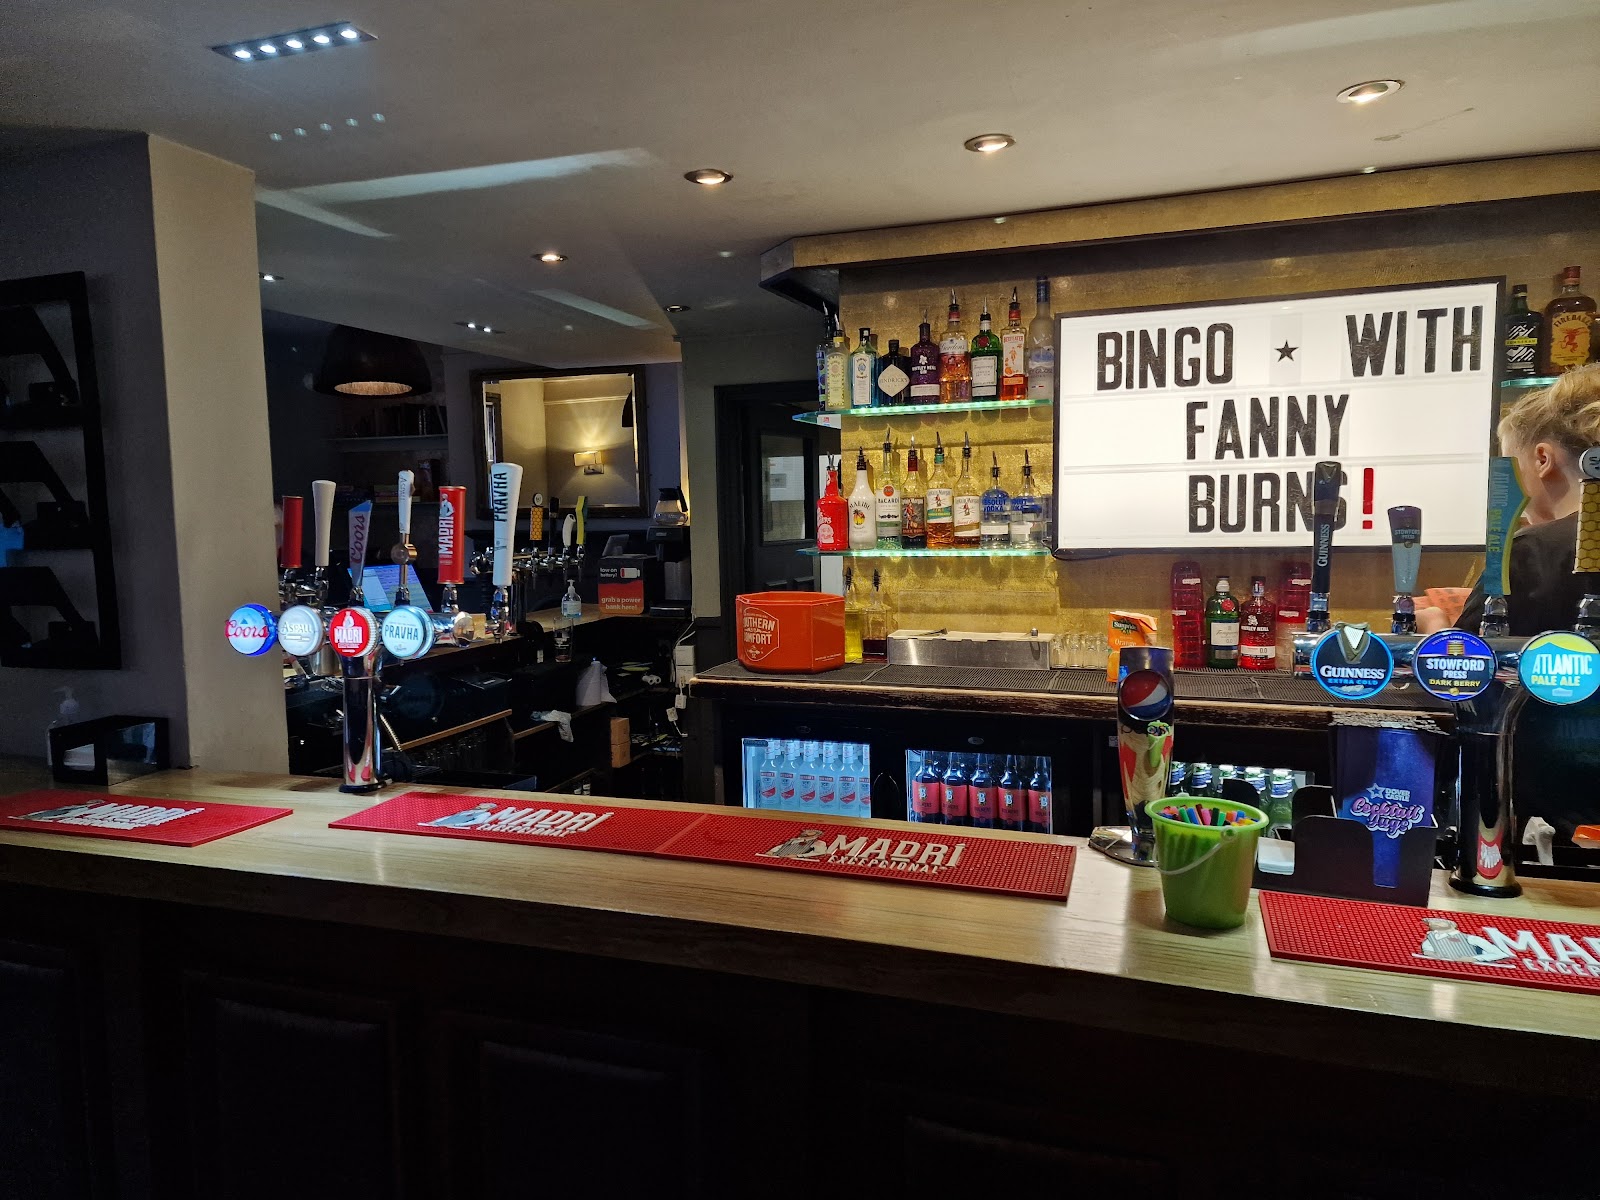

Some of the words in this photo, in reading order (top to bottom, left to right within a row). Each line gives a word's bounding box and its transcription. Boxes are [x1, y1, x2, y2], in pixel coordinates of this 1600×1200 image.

[1097, 323, 1234, 391] BINGO
[1346, 305, 1483, 378] WITH
[1186, 394, 1349, 460] FANNY
[493, 472, 508, 522] PRAVHA
[350, 514, 365, 563] Coors
[1316, 524, 1330, 567] GUINNESS
[1488, 534, 1502, 552] ALE
[224, 619, 269, 638] Coors
[384, 624, 419, 641] PRAVHA
[743, 616, 775, 632] OUTHERN
[743, 631, 772, 645] OMFORT
[1114, 638, 1137, 647] Orange
[1320, 665, 1386, 680] GUINNESS
[1425, 658, 1485, 672] STOWFORD
[1532, 653, 1593, 675] ATLANTIC
[1429, 678, 1452, 687] DARK
[1453, 679, 1481, 687] BERRY
[1442, 670, 1468, 679] PRESS
[1531, 674, 1557, 686] PALE
[1560, 675, 1581, 687] ALE
[1351, 797, 1425, 822] Cocktail
[827, 855, 944, 875] EXCEPCIONAL
